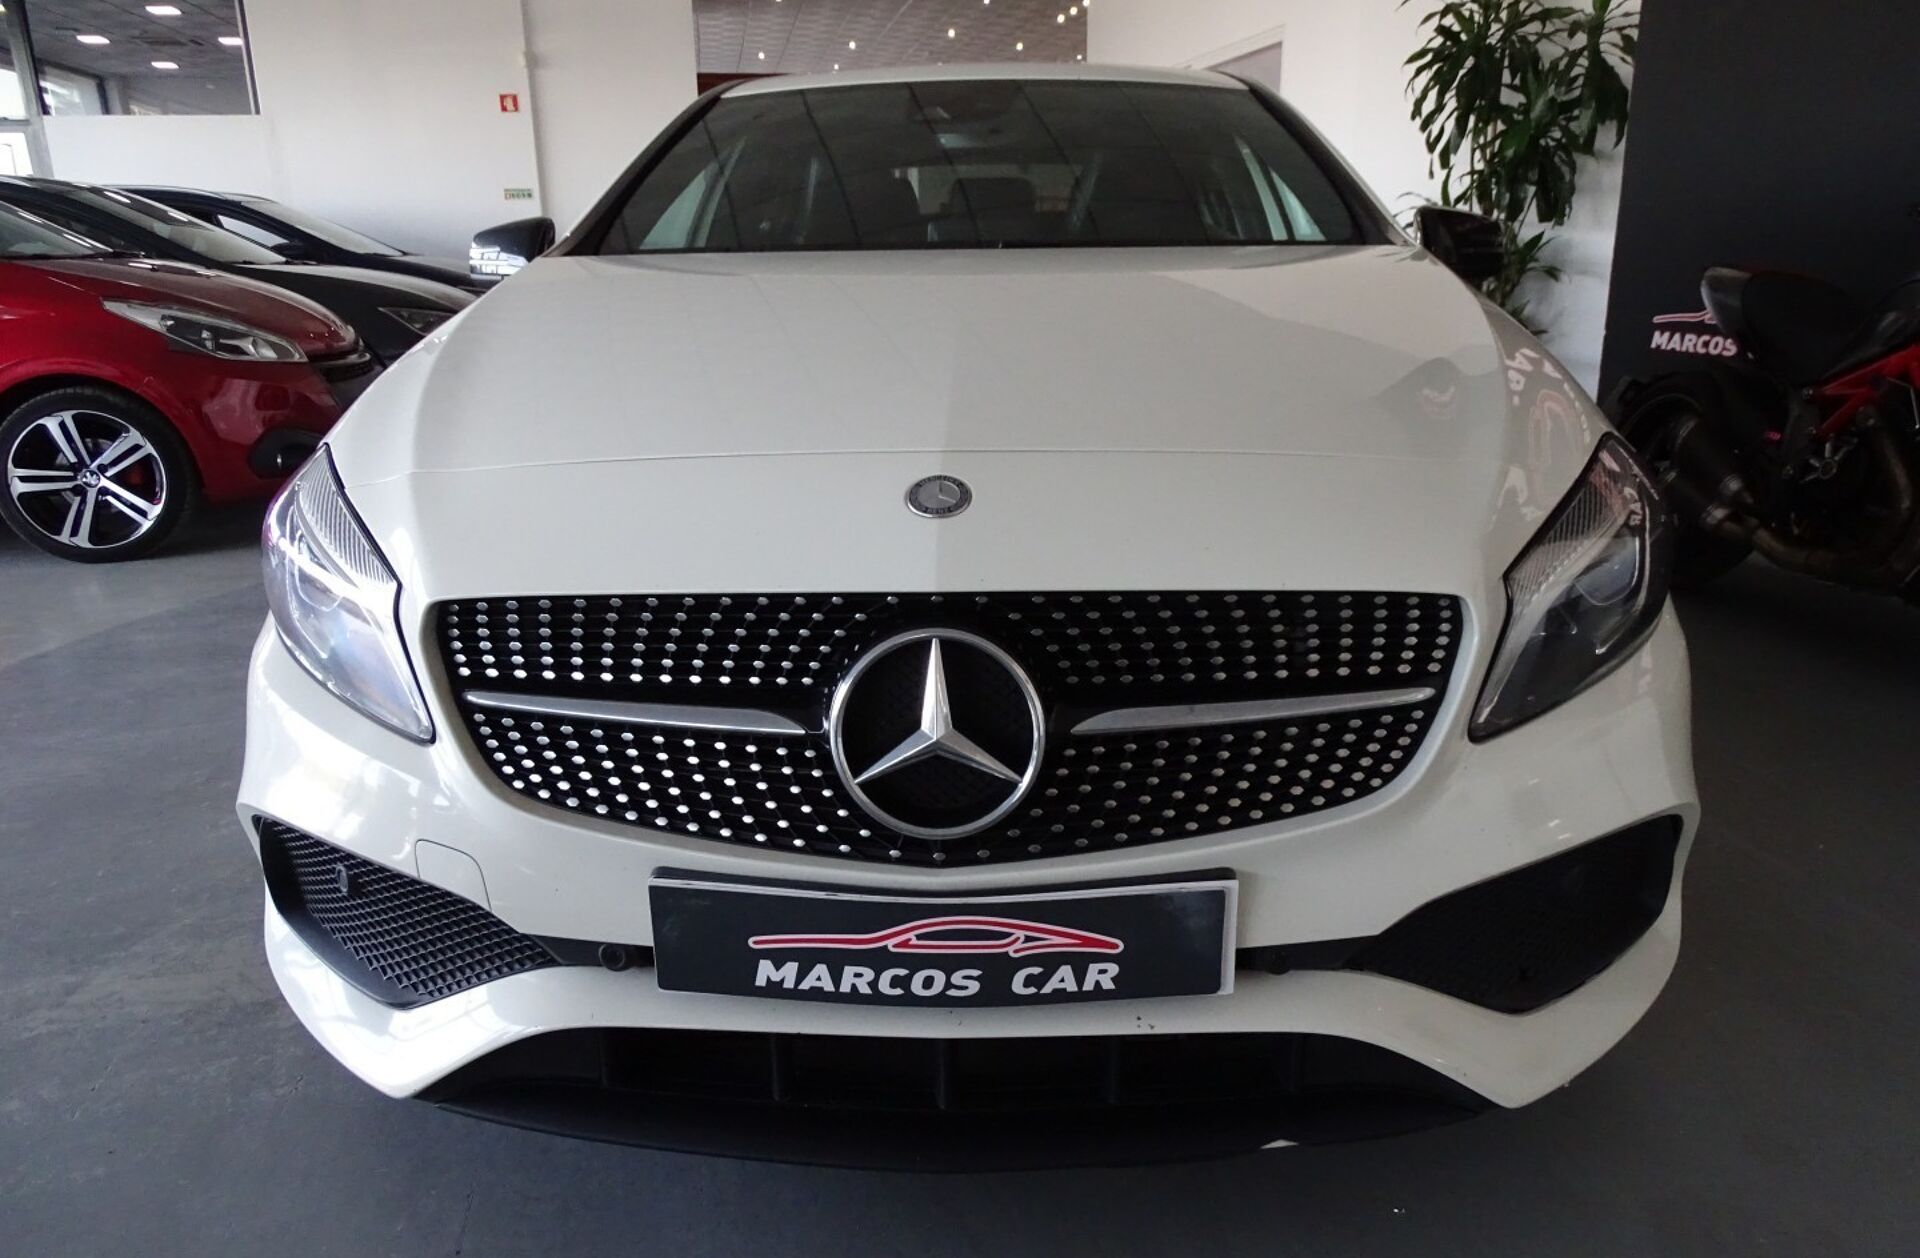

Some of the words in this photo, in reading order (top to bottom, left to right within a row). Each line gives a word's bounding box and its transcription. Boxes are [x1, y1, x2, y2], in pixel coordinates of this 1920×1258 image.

[1650, 330, 1738, 357] MARCOS
[755, 959, 983, 998] MARCOS
[1011, 962, 1120, 995] CAR
